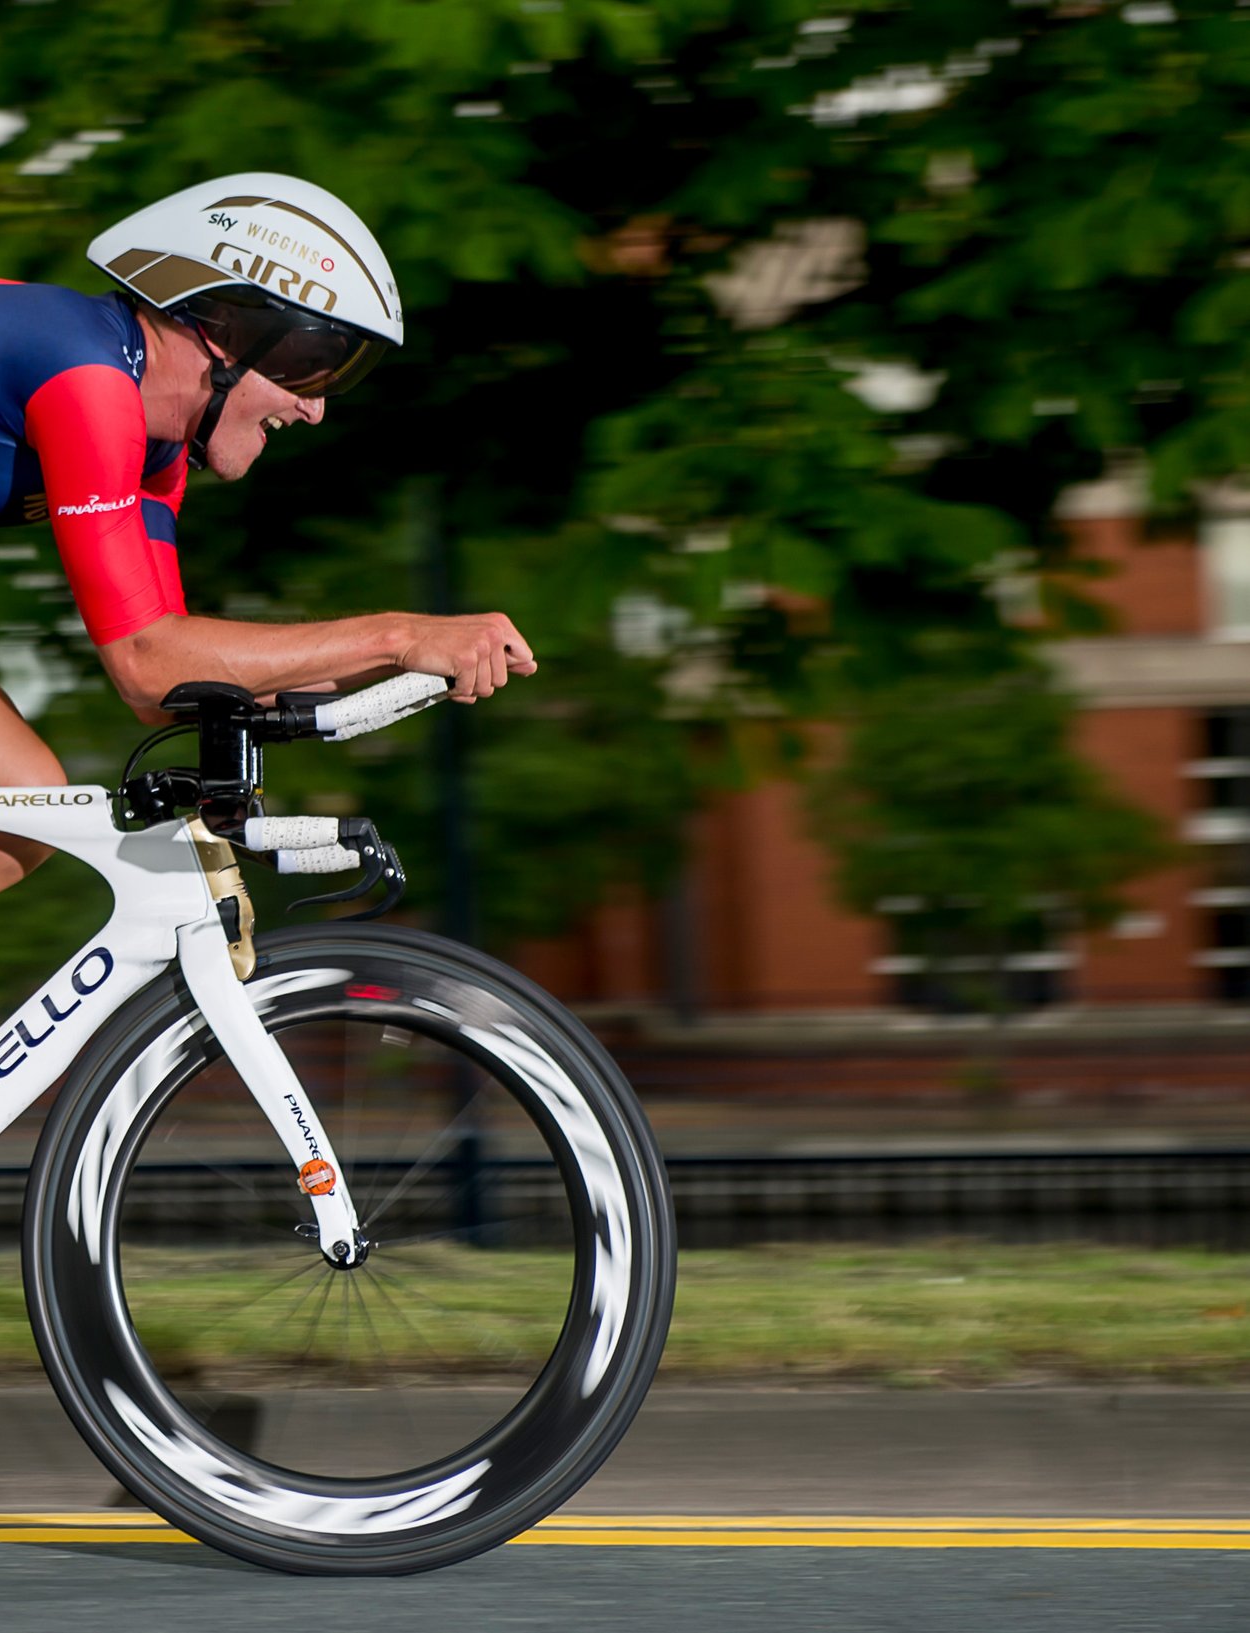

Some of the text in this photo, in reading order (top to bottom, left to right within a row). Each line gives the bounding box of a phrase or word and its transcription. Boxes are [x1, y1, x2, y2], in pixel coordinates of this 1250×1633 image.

[208, 212, 239, 232] sky
[247, 222, 320, 265] WIGGINS
[210, 241, 338, 313] GIRO
[57, 494, 136, 516] PINARELLO
